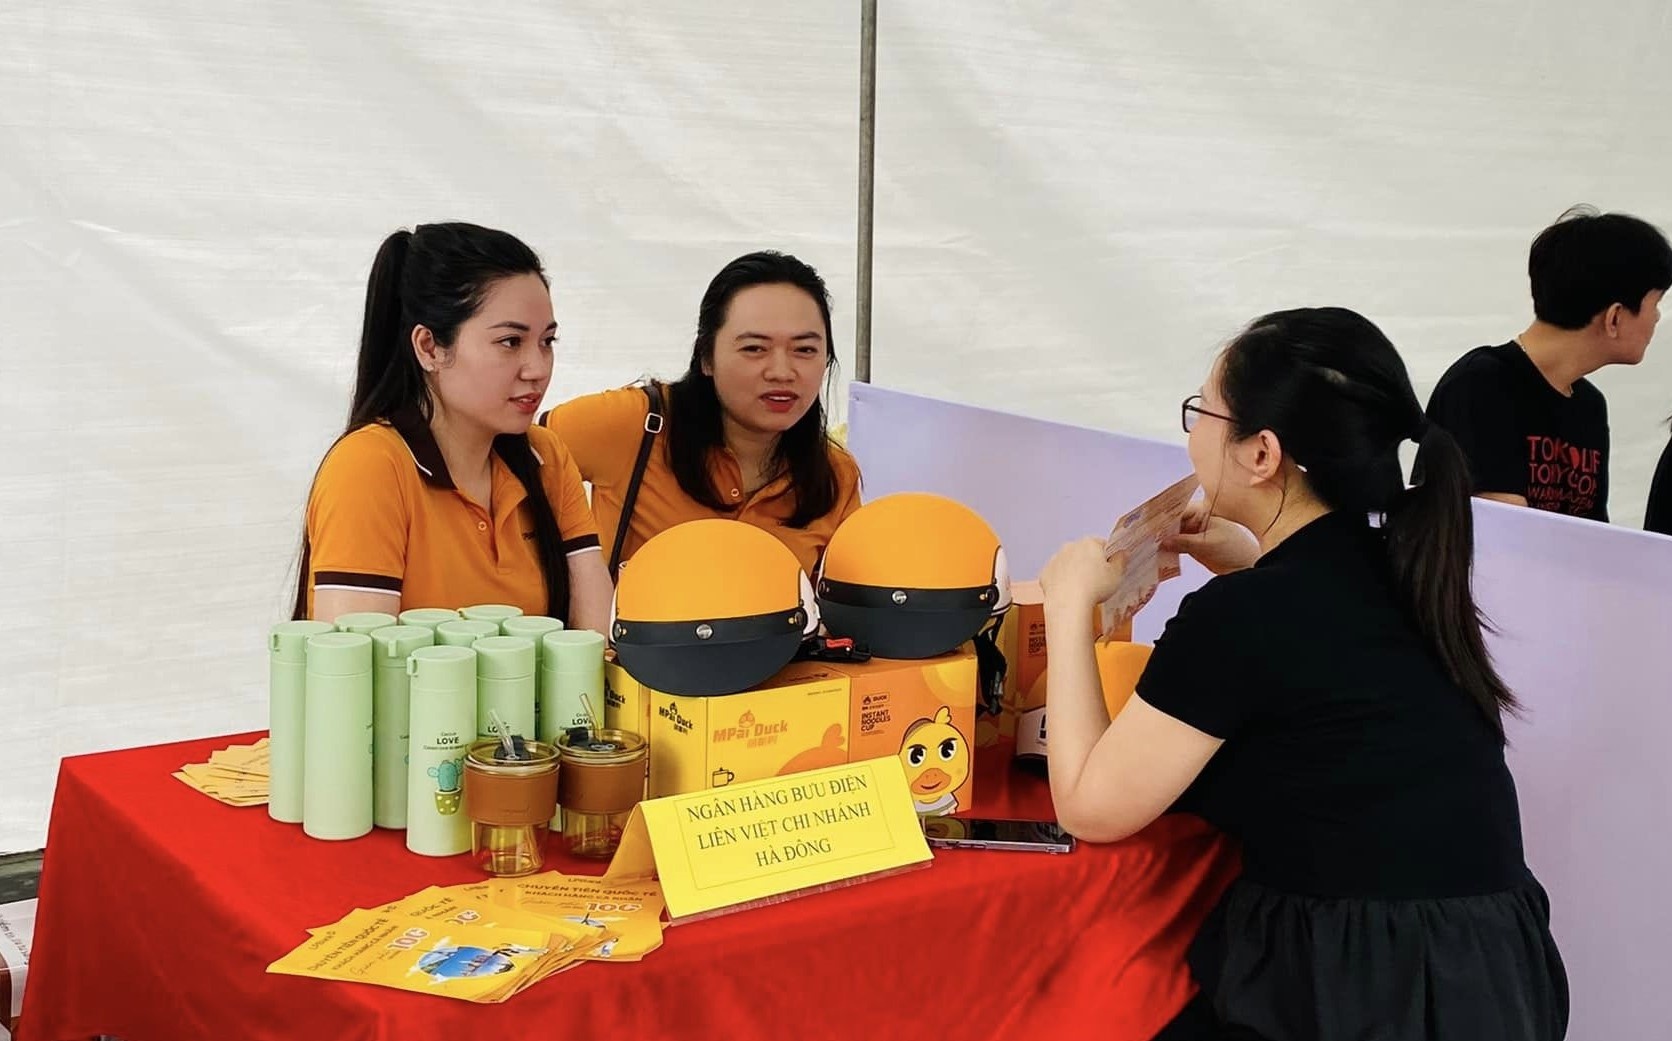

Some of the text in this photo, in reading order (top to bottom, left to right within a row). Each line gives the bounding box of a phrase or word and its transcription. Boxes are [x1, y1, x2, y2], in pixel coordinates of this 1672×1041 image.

[676, 714, 693, 730] Duck
[861, 715, 890, 725] NOODLES
[862, 709, 889, 720] INSTANT
[487, 725, 510, 733] LOE
[713, 727, 749, 743] MPai
[754, 720, 788, 736] Duck
[861, 724, 874, 732] CUP
[436, 737, 460, 745] LOVE
[686, 774, 868, 822] NGÂN HÀNG BƯU ĐIỆN
[697, 801, 871, 850] LIÊN VIỆT CHI NHÁNH
[755, 838, 832, 867] HÀ ĐÔNG
[387, 928, 428, 949] 10G
